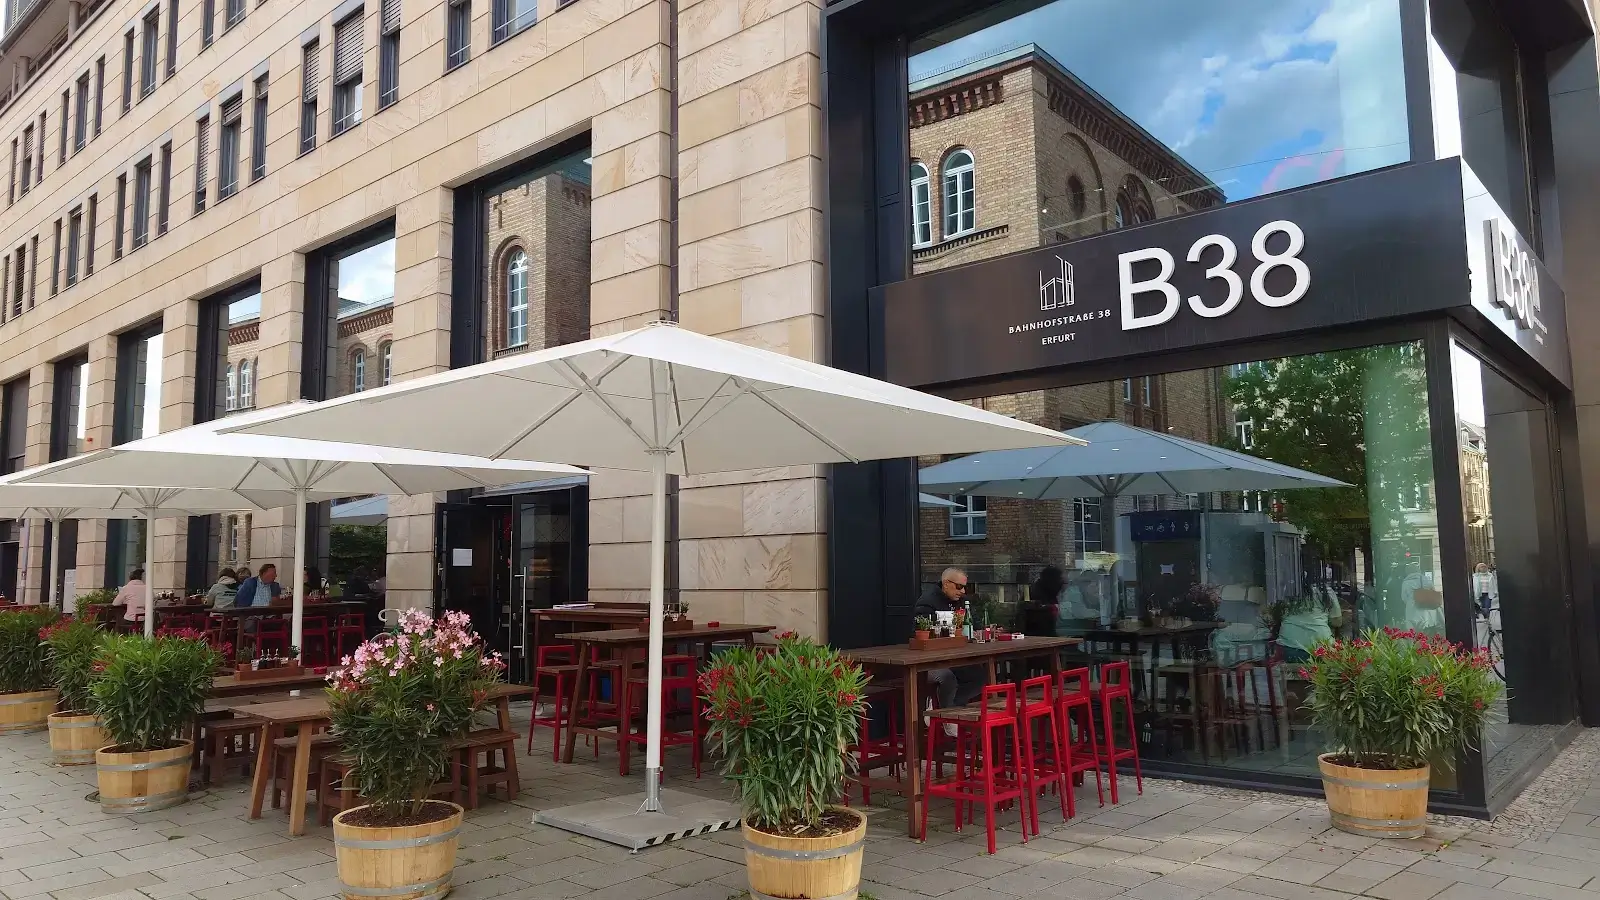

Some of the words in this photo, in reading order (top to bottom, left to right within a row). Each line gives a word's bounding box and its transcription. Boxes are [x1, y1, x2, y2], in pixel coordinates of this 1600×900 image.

[1118, 220, 1311, 331] B38
[1097, 308, 1112, 319] 38
[1041, 333, 1076, 346] ERFURT
